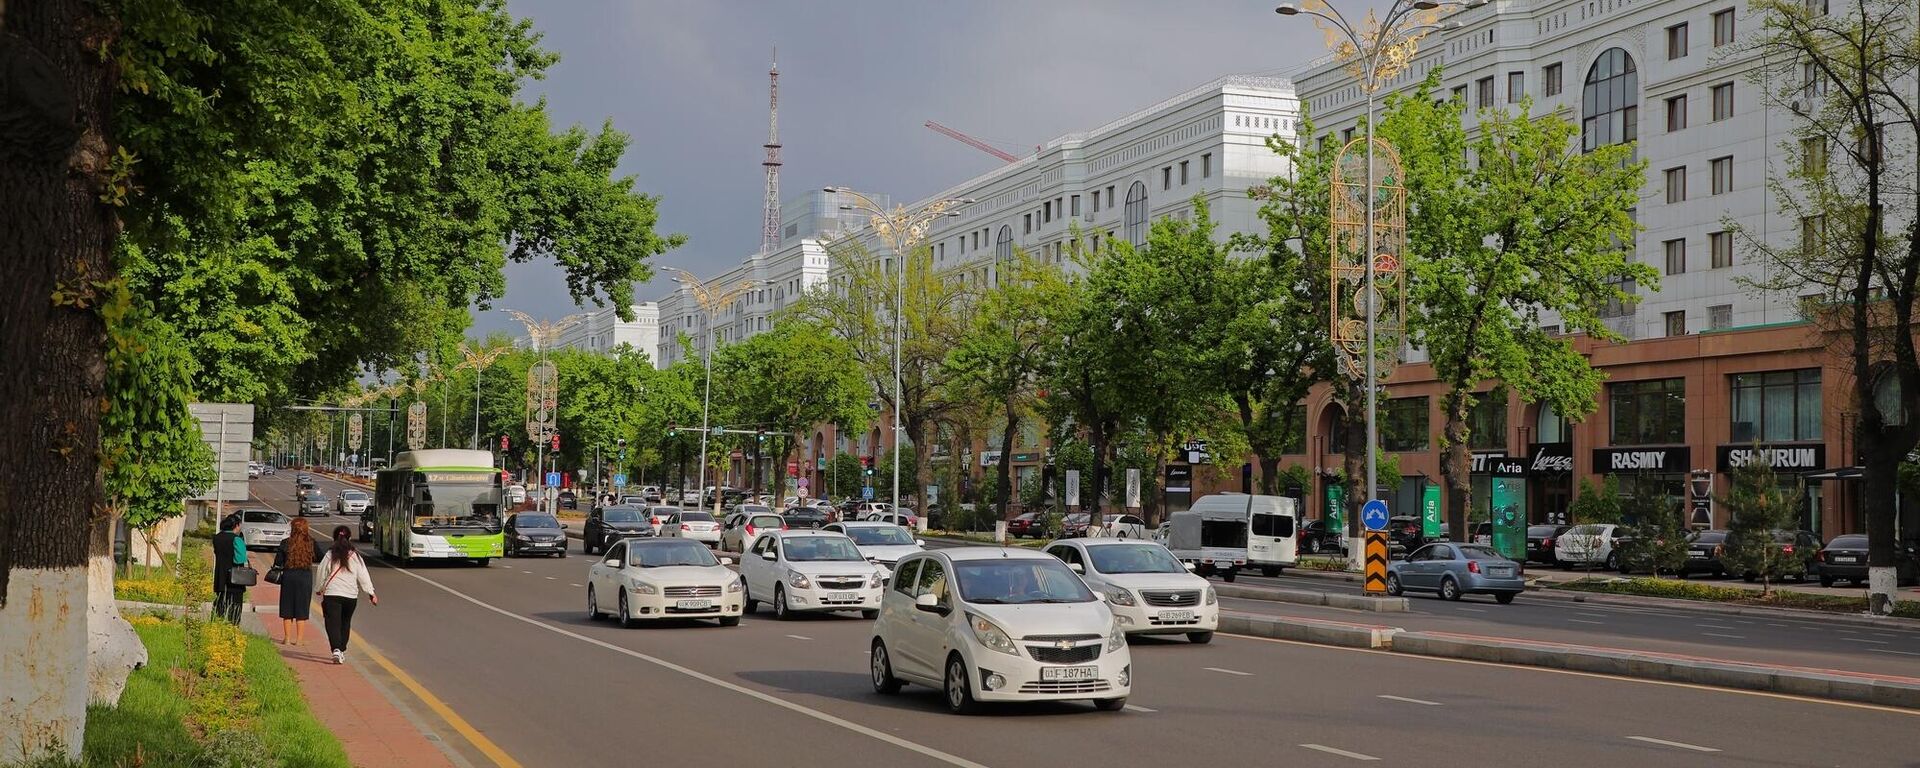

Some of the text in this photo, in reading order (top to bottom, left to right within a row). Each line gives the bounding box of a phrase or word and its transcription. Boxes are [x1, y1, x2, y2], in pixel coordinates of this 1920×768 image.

[1497, 462, 1522, 473] Aria
[1611, 452, 1666, 469] RASMIY
[1329, 499, 1337, 519] Aria
